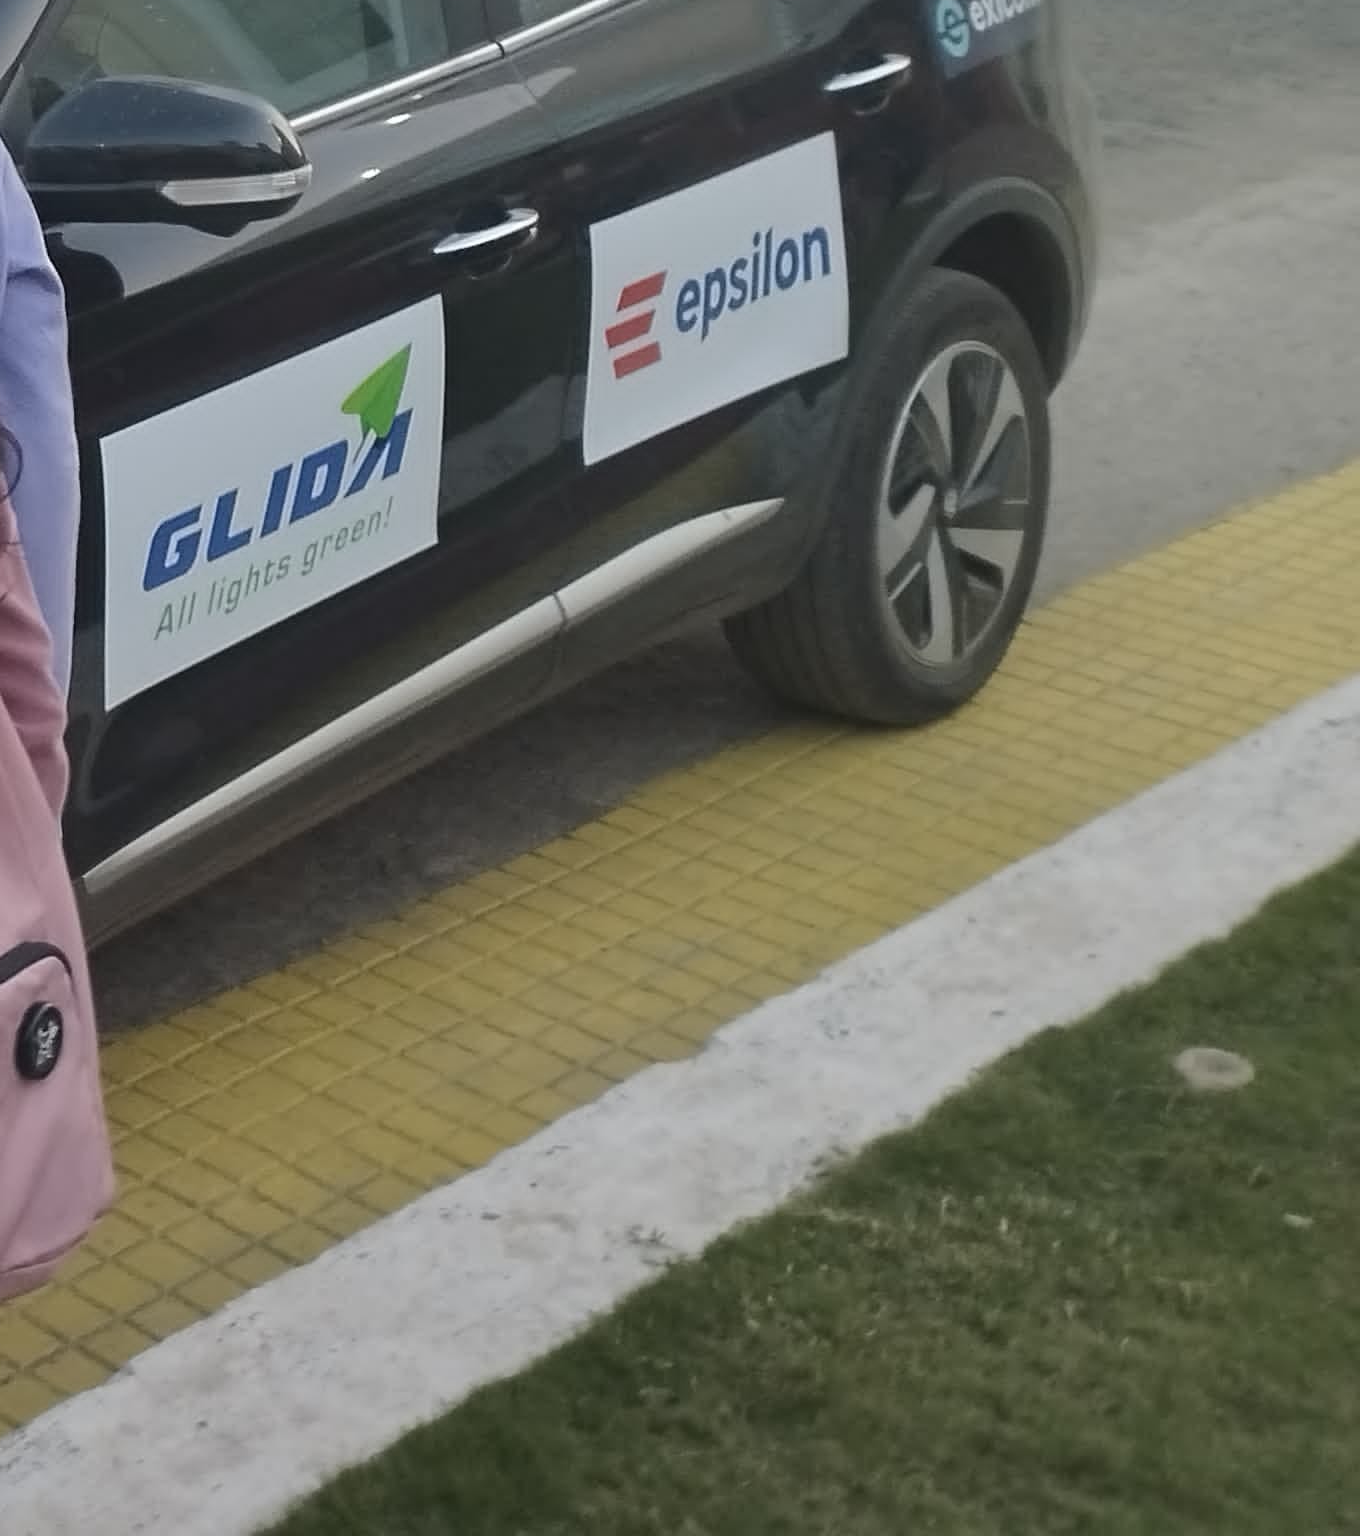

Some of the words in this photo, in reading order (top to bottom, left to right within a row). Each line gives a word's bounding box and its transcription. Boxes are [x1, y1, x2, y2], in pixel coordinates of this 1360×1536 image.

[676, 226, 831, 344] epsilon
[143, 407, 413, 592] GLIDA
[154, 591, 197, 641] All
[207, 556, 290, 615] lights
[301, 496, 393, 576] green!
